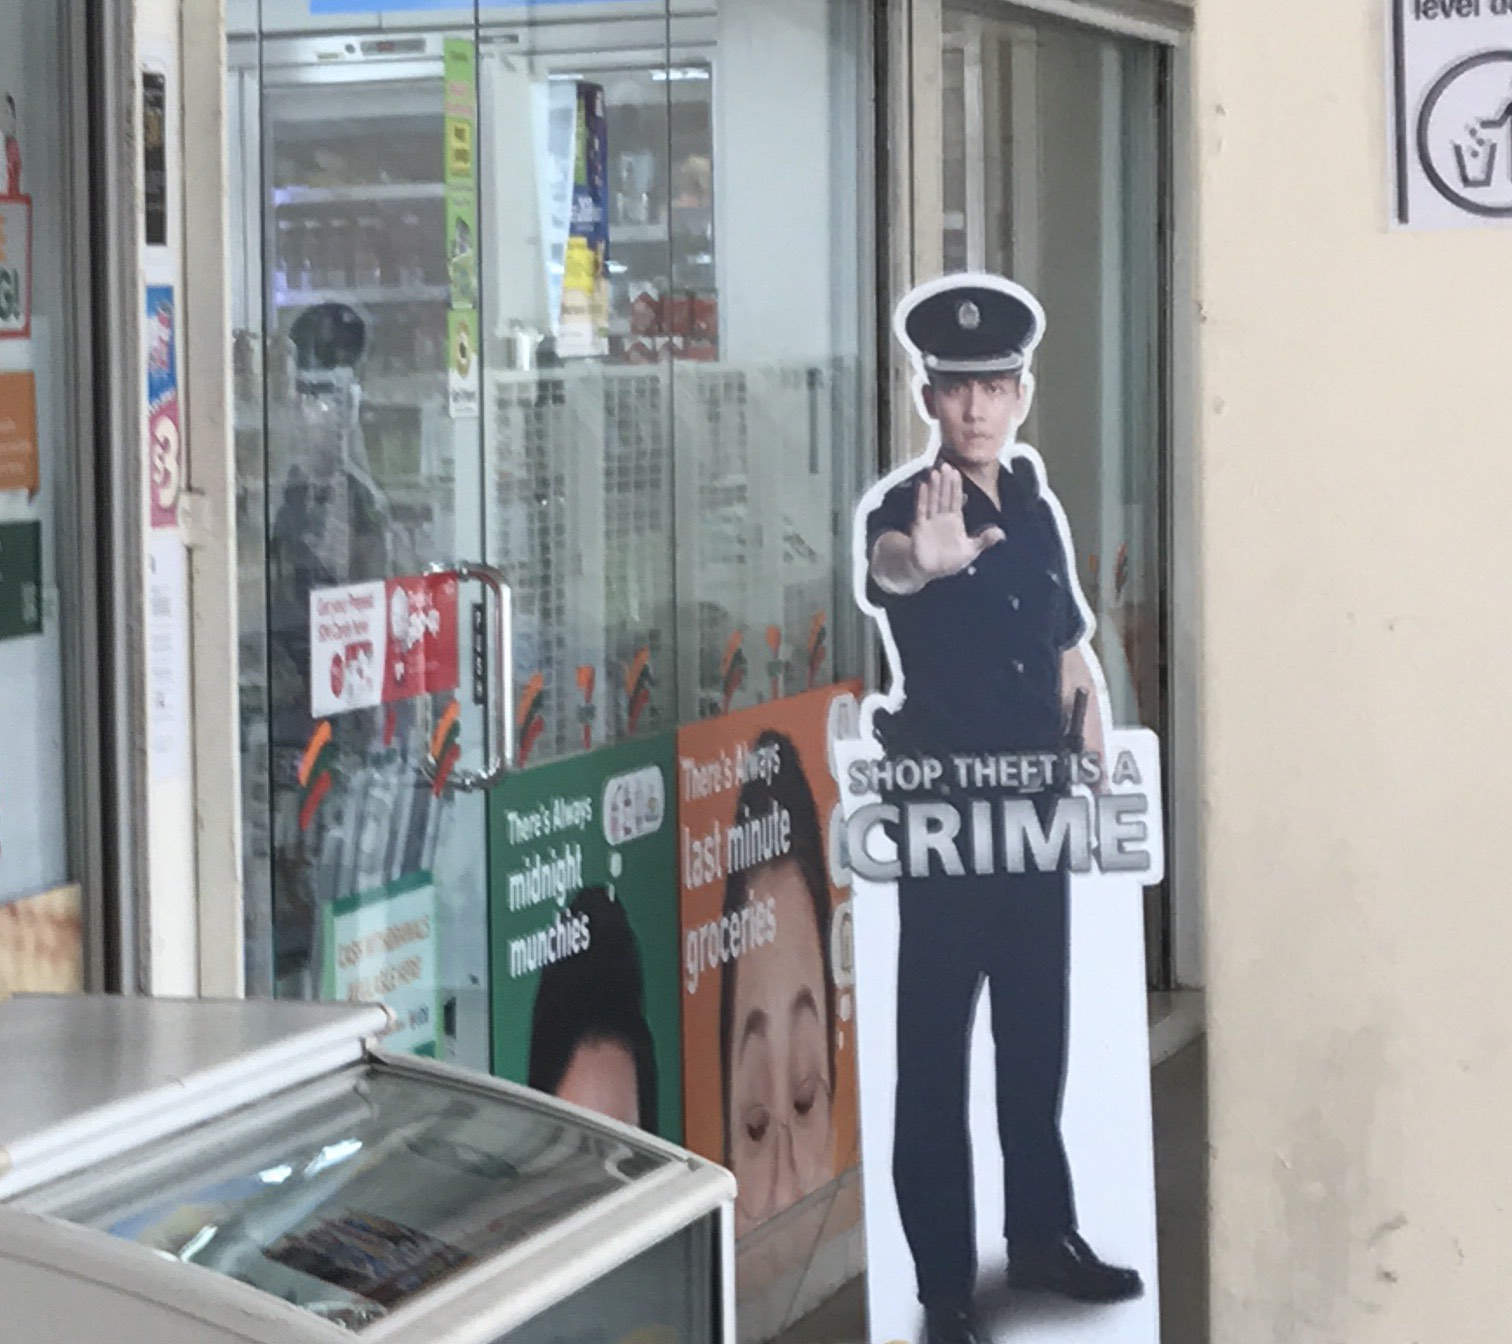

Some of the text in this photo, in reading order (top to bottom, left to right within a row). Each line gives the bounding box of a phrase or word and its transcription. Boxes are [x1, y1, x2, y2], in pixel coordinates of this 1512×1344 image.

[848, 750, 1143, 795] SHOP THEFT IS A
[508, 842, 584, 913] midnight
[681, 798, 792, 892] last minute
[845, 792, 1152, 884] CRIME
[509, 906, 591, 979] munchies
[683, 888, 778, 996] groceries
